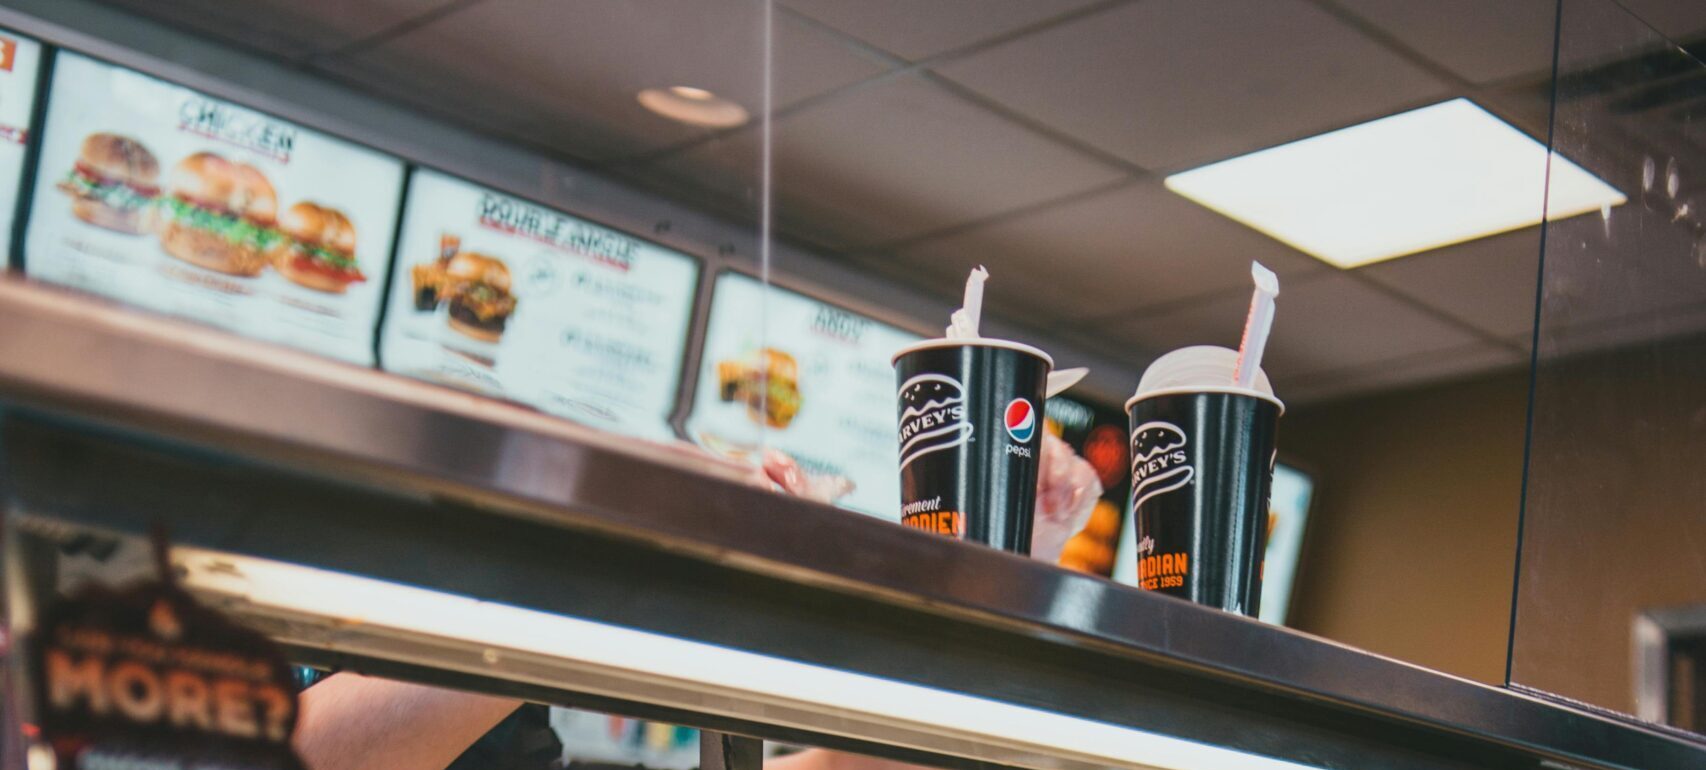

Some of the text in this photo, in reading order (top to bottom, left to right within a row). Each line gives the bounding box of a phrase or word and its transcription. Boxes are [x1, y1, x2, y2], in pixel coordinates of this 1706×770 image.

[1005, 444, 1032, 458] pepsi
[1133, 450, 1187, 486] RVEY'S
[901, 495, 941, 518] rement
[1161, 575, 1184, 588] 1959
[46, 651, 292, 740] MORE?
